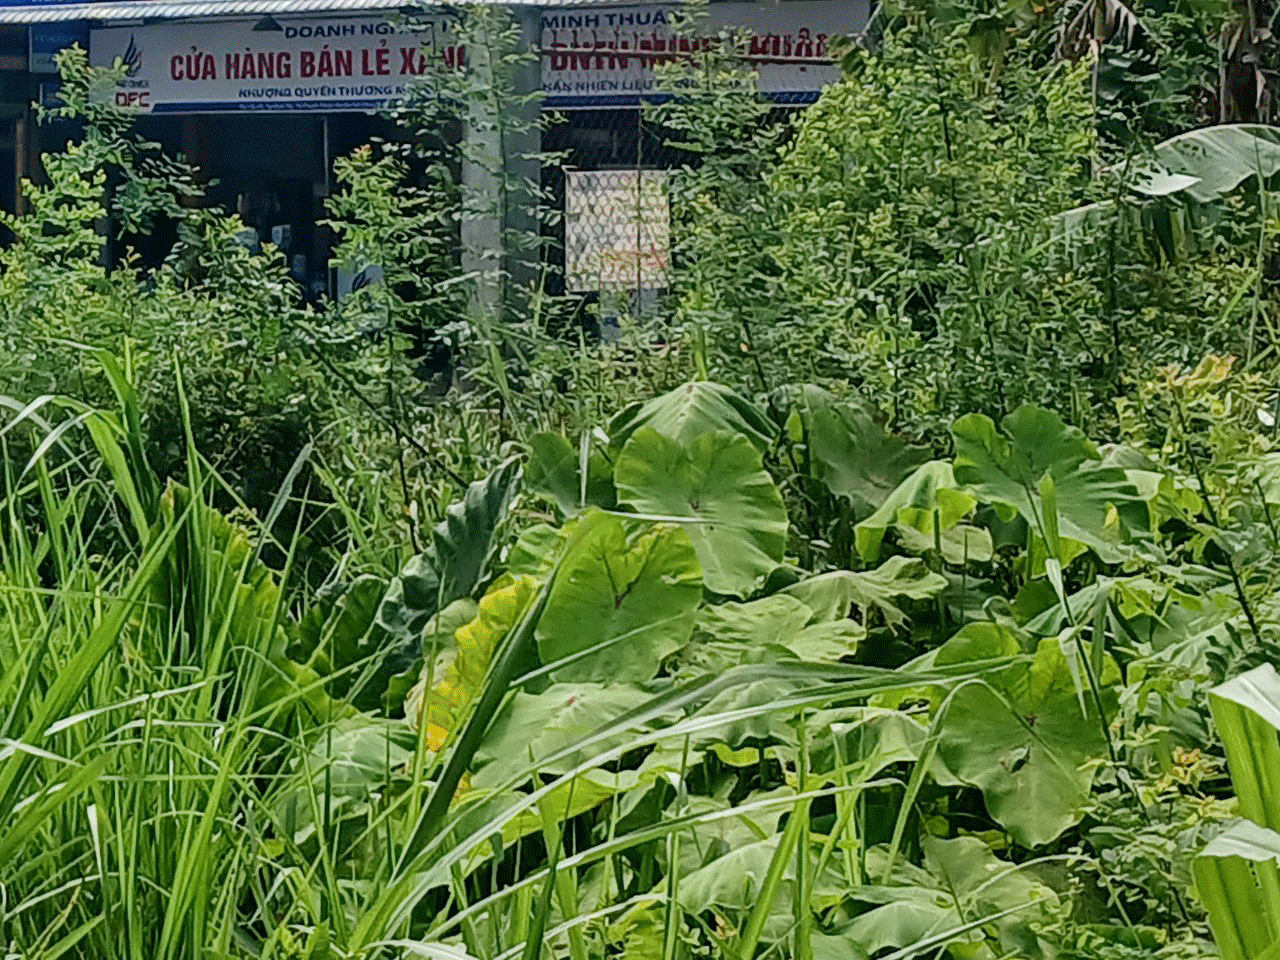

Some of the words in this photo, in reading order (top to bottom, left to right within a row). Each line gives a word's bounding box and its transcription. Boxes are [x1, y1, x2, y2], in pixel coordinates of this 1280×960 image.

[284, 24, 355, 39] DOANH
[541, 14, 600, 29] MINH
[170, 45, 217, 81] CỬA
[225, 46, 292, 79] HÀNG
[300, 44, 353, 79] BÁN
[361, 38, 391, 76] LẺ
[115, 91, 150, 107] DFC
